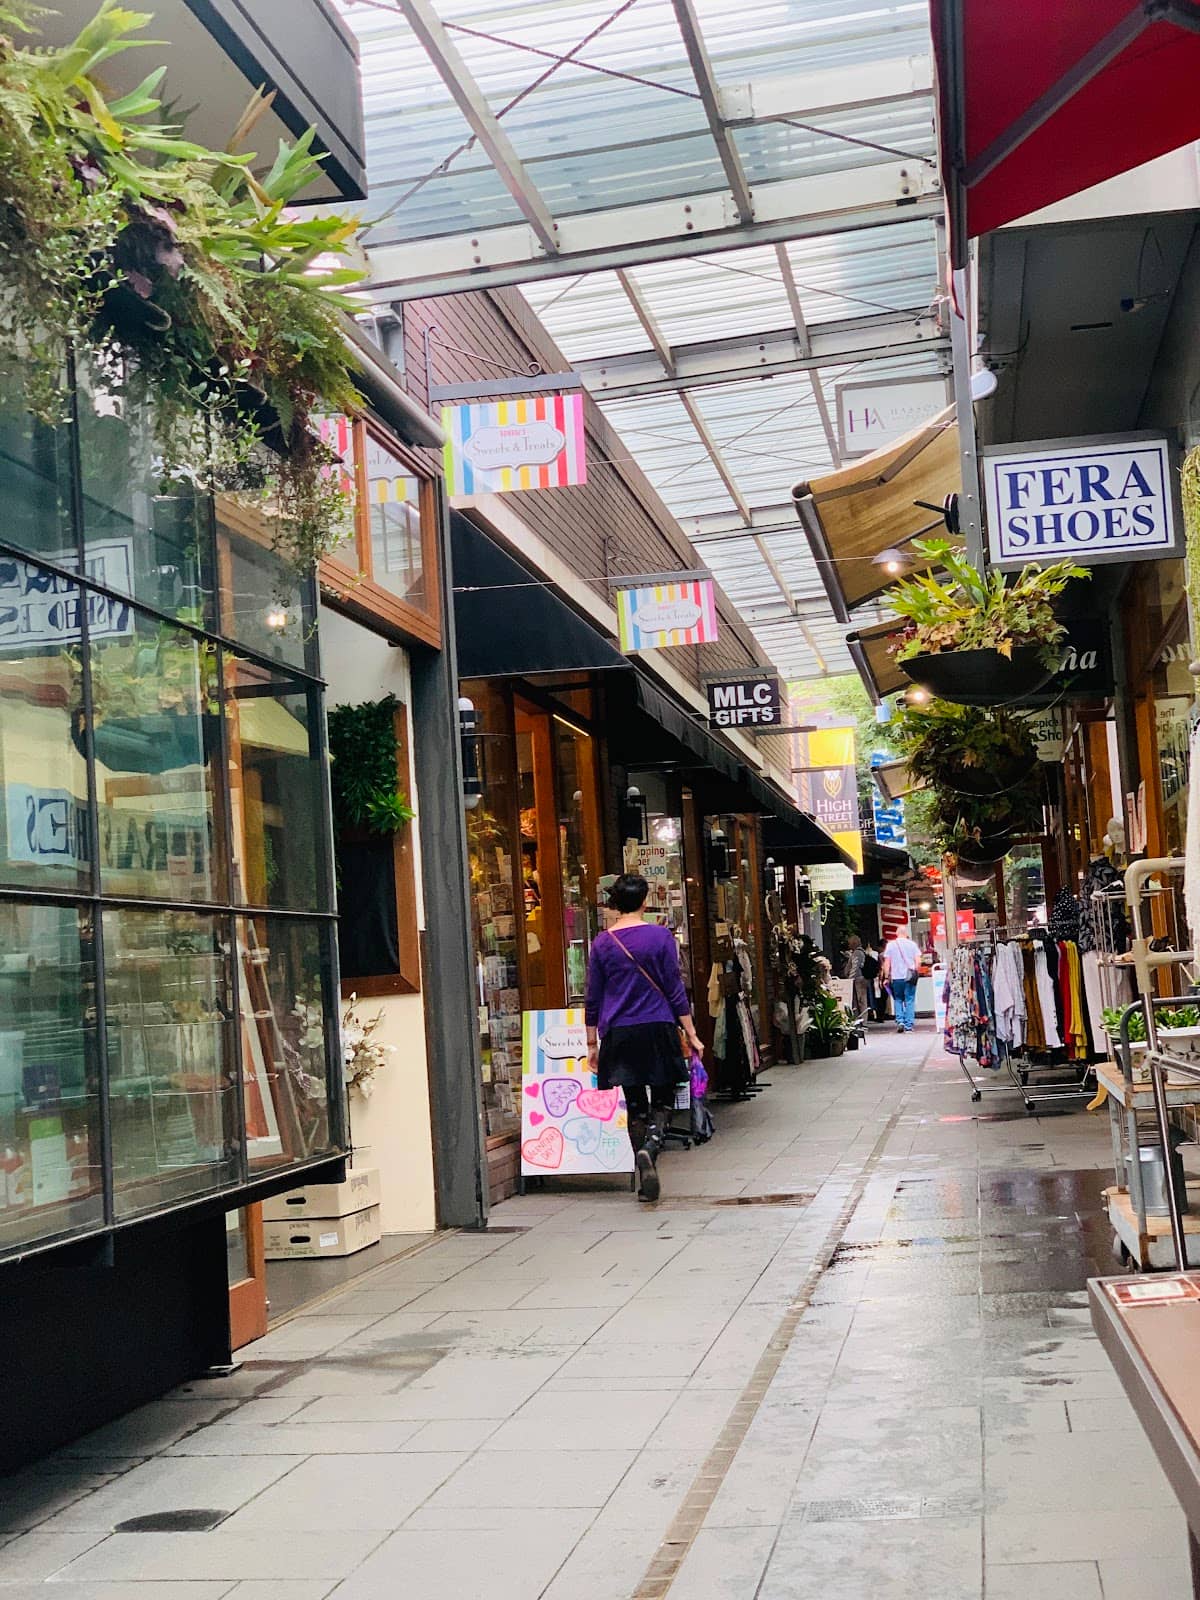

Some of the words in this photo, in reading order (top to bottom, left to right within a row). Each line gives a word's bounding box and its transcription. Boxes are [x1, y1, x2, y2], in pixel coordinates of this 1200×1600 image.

[848, 407, 885, 432] HA
[473, 440, 509, 456] Sweets
[513, 442, 521, 453] &
[524, 436, 556, 451] Treats
[1003, 460, 1156, 510] FERA
[1008, 504, 1155, 548] SHOES
[713, 683, 772, 708] MLC
[716, 706, 774, 725] GIFTS
[817, 800, 852, 813] HIGH
[545, 1038, 575, 1047] Sweets
